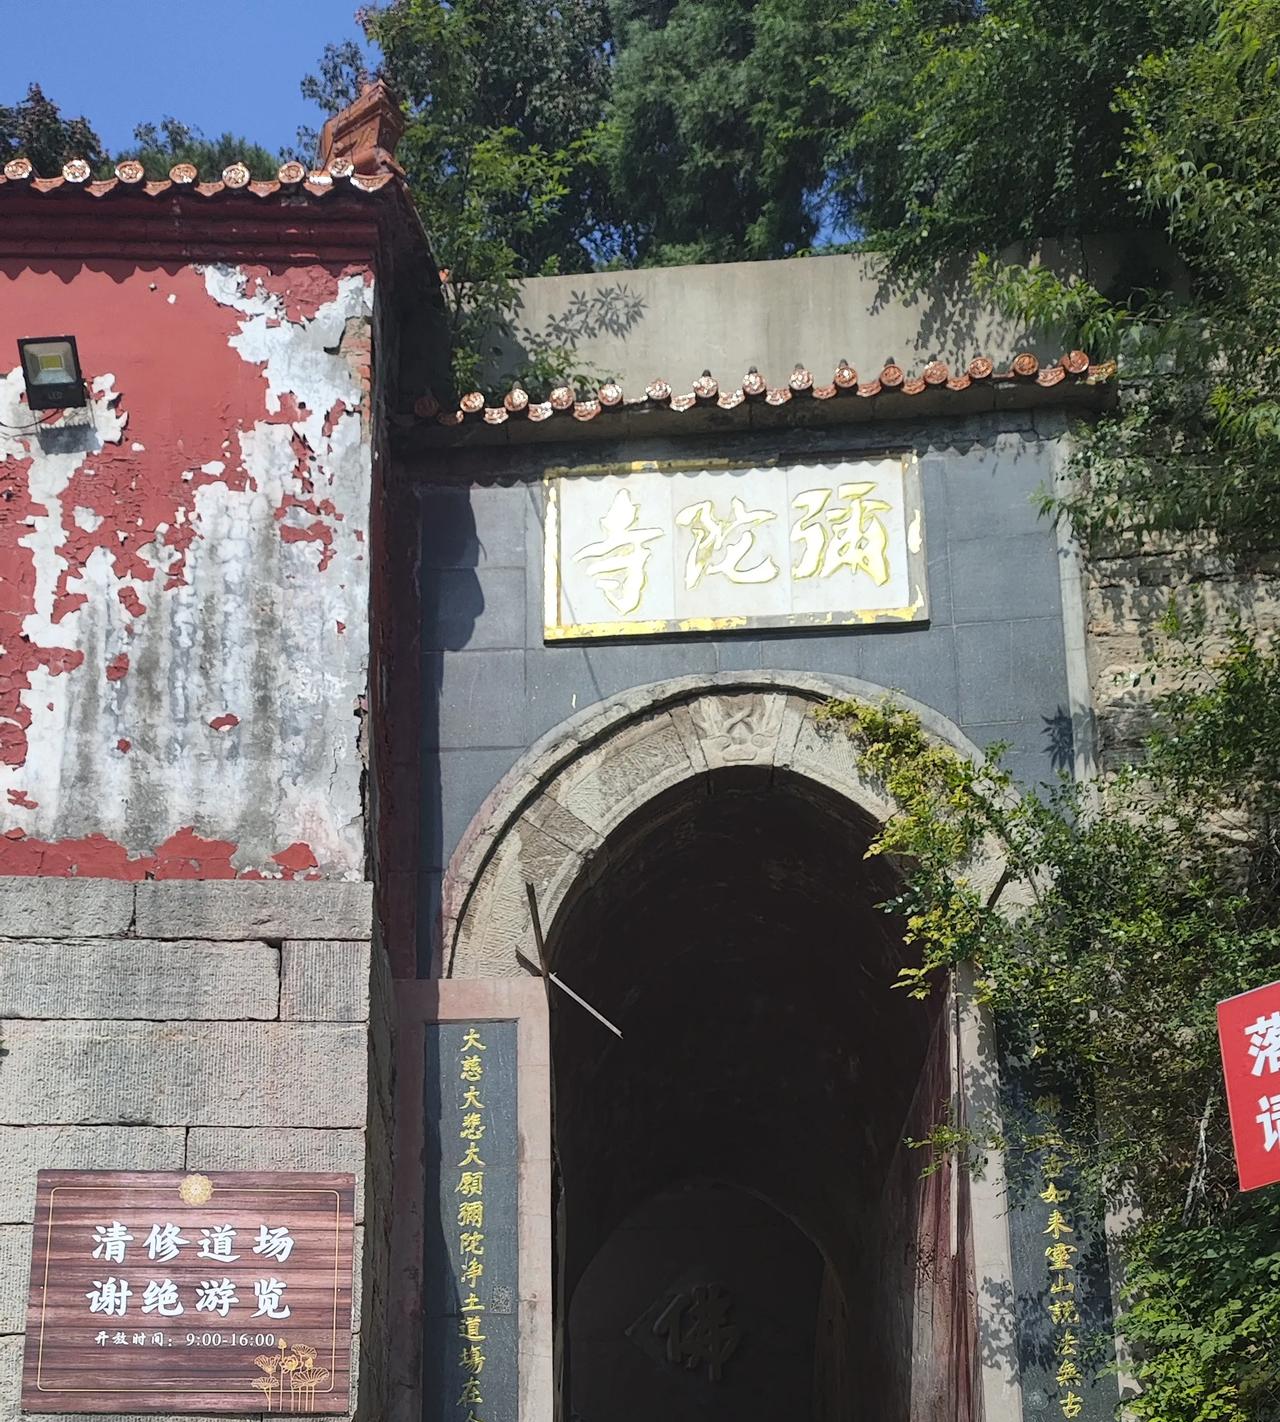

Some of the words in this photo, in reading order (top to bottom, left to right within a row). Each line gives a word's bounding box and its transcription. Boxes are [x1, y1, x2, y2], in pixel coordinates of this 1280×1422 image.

[91, 1220, 295, 1264] 清修道场
[85, 1277, 292, 1319] 谢绝游览
[186, 1332, 275, 1347] 9:00-16:00
